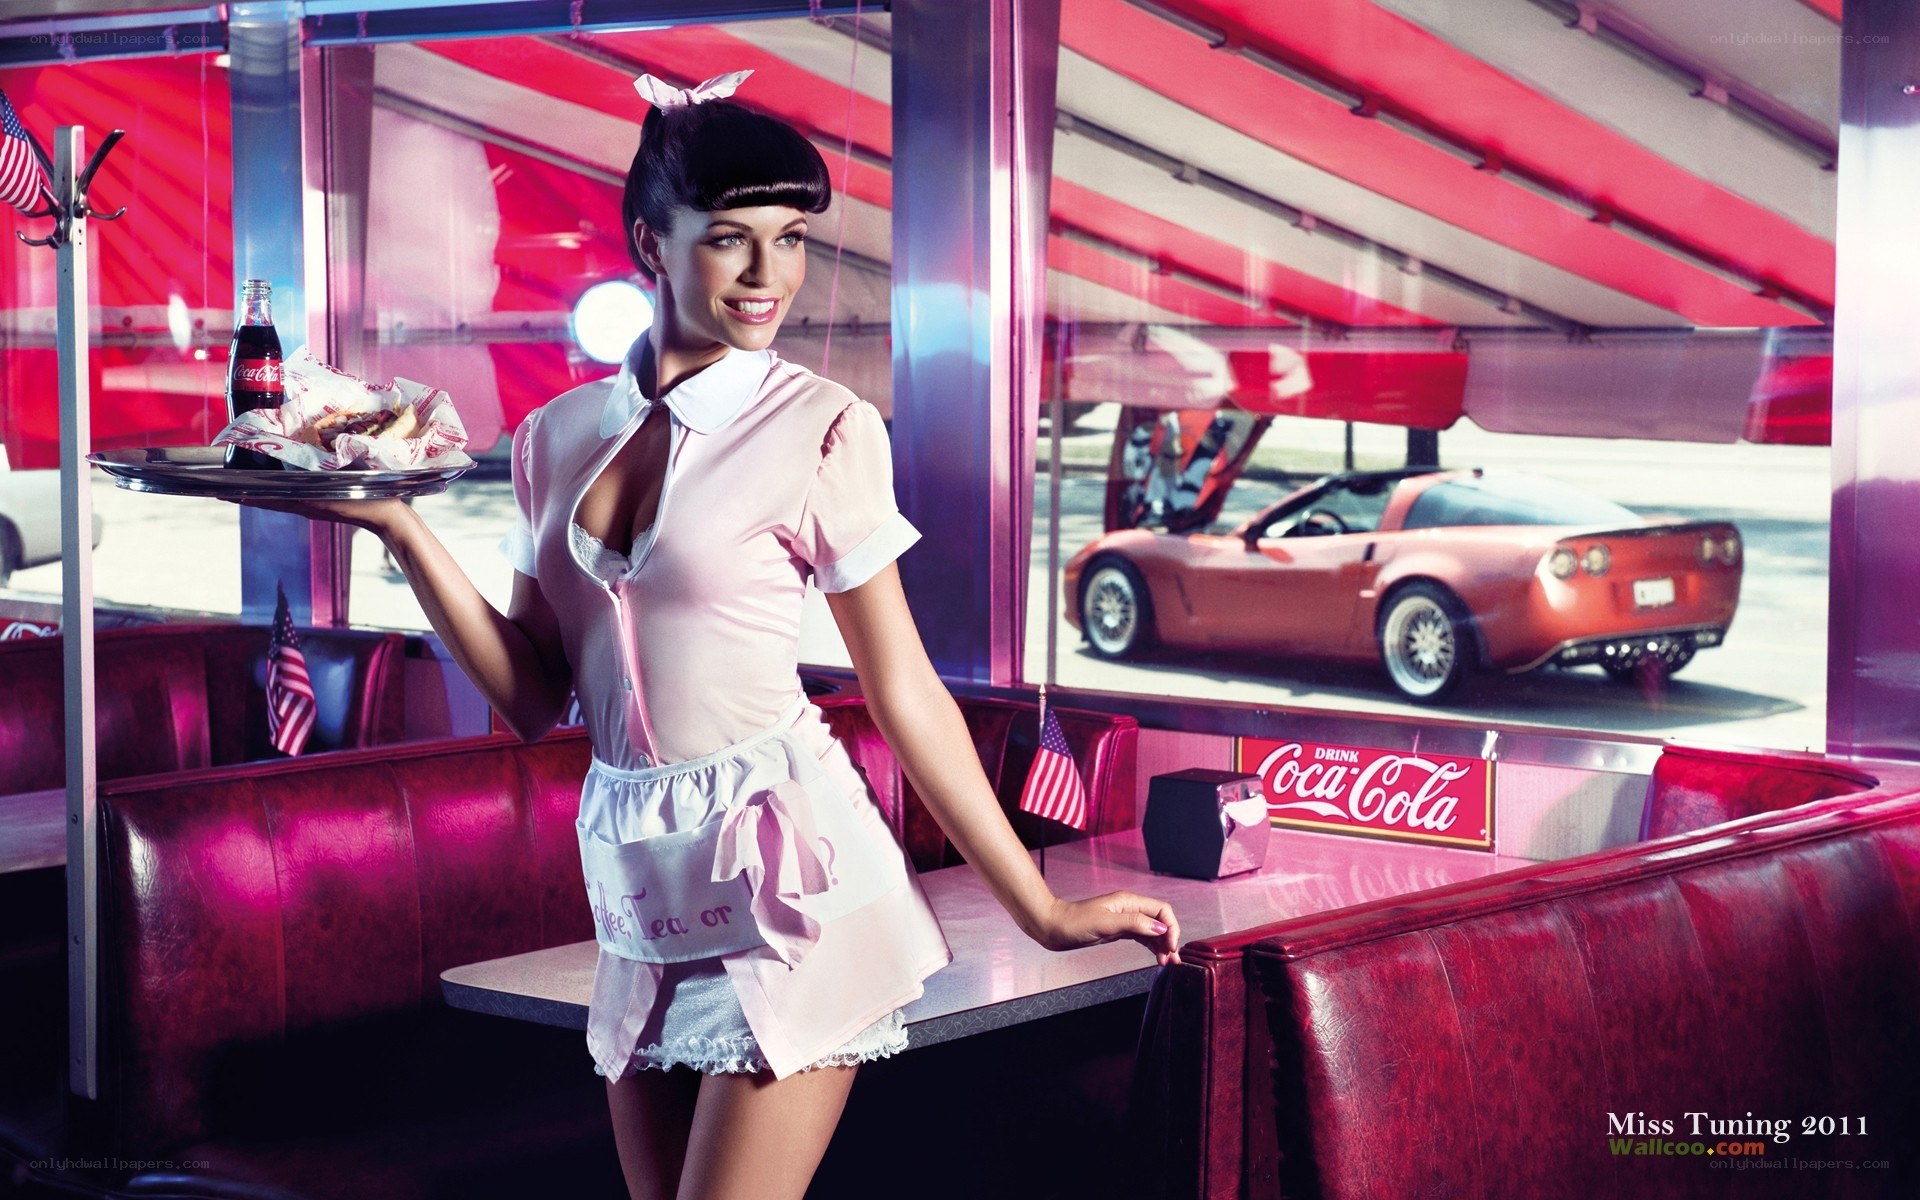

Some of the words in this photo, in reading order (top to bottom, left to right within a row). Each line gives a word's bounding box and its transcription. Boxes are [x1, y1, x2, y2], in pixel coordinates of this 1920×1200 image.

[1314, 747, 1360, 763] DRINK
[584, 876, 632, 944] offee,
[620, 887, 689, 941] Tea
[700, 904, 733, 928] or
